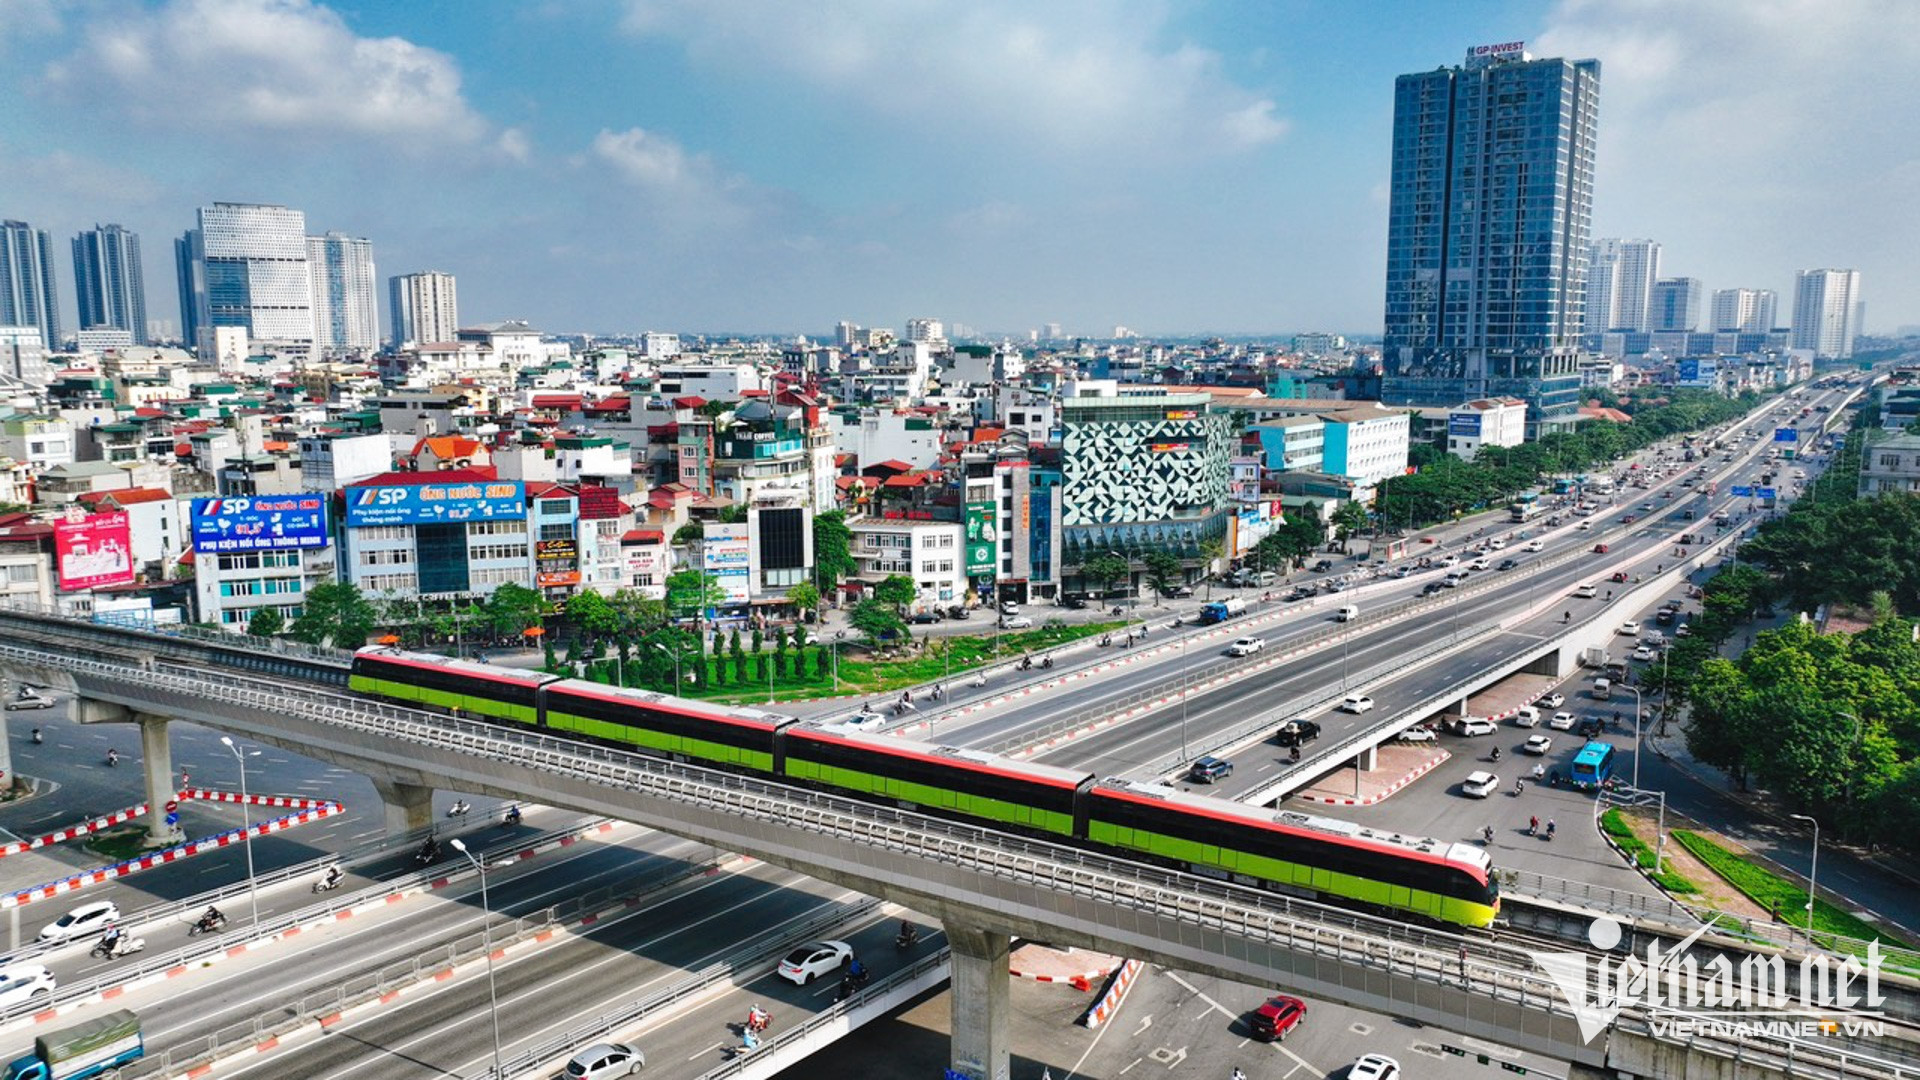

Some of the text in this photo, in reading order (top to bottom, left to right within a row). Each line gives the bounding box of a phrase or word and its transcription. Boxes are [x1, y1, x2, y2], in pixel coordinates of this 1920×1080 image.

[378, 488, 408, 505] SP
[419, 484, 517, 501] ỐNG NƯỚC SINO
[223, 498, 250, 515] SP
[200, 536, 321, 551] PHỤ KIỆN NỐI ỐNG THÔNG MINH
[422, 593, 456, 601] COFFEE
